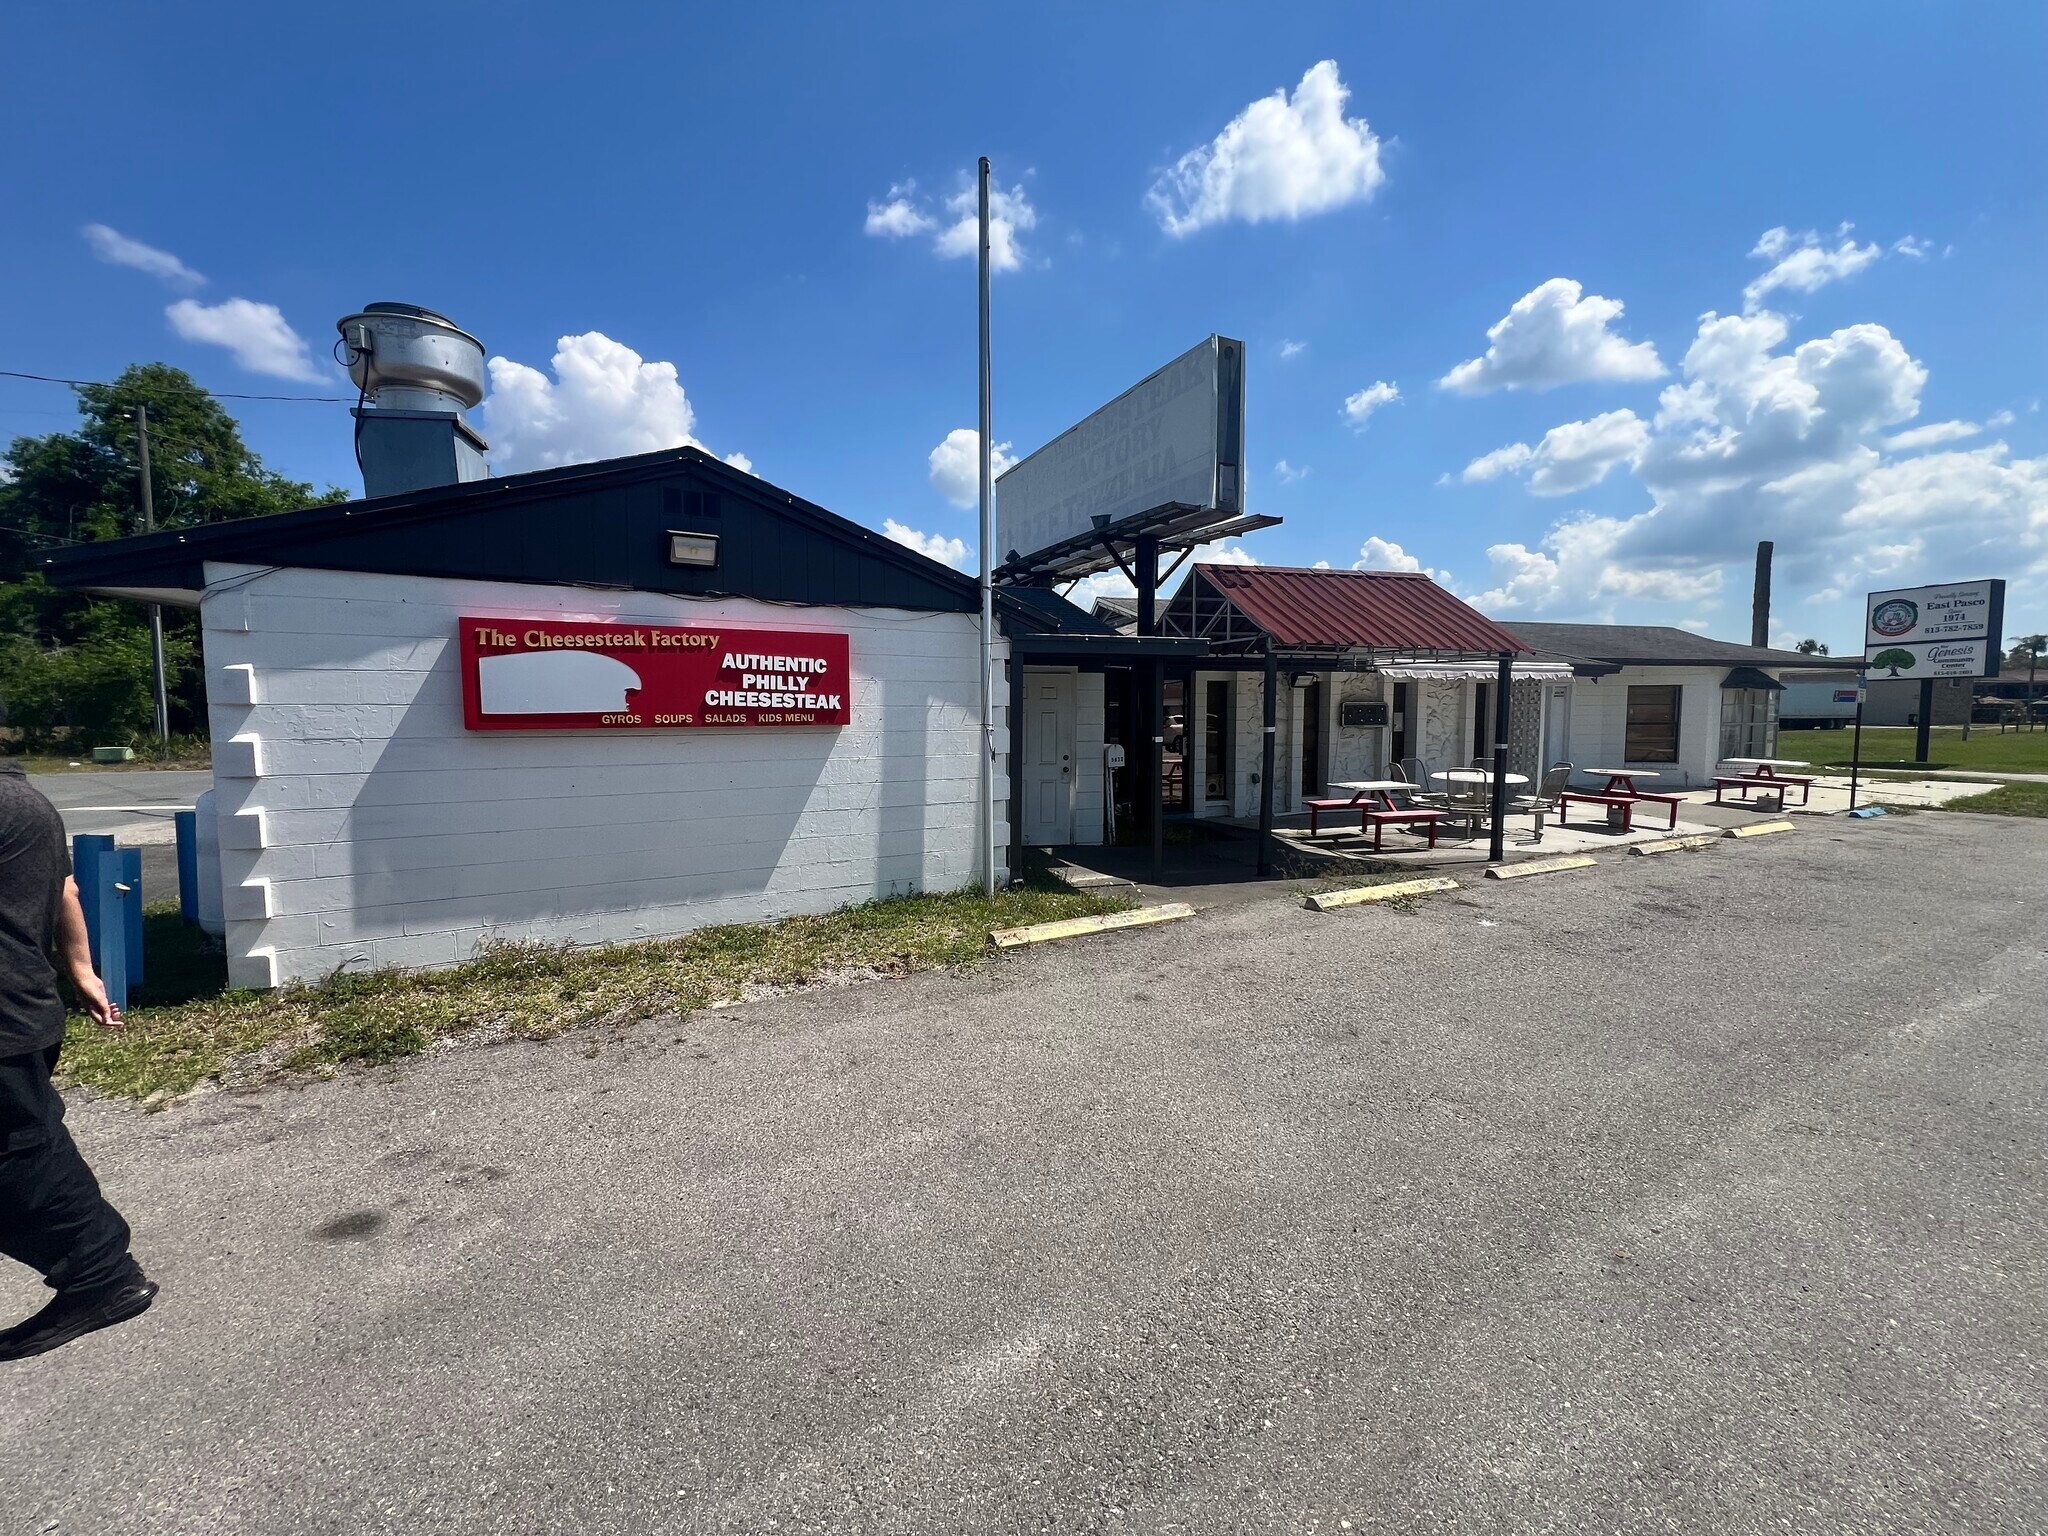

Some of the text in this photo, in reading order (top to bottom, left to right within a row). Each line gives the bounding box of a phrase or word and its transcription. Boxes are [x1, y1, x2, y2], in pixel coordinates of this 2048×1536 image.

[1927, 599, 1985, 610] East Pasco
[1943, 613, 1966, 622] 1974
[475, 627, 720, 650] The Cheesesteak Factory
[1926, 645, 1974, 661] Genesis
[721, 652, 828, 674] AUTHENTIC
[742, 673, 810, 692] PHILLY
[705, 689, 842, 710] CHEESESTEAK
[601, 713, 815, 724] GYROS SOUPS SALADS KIDS MENU
